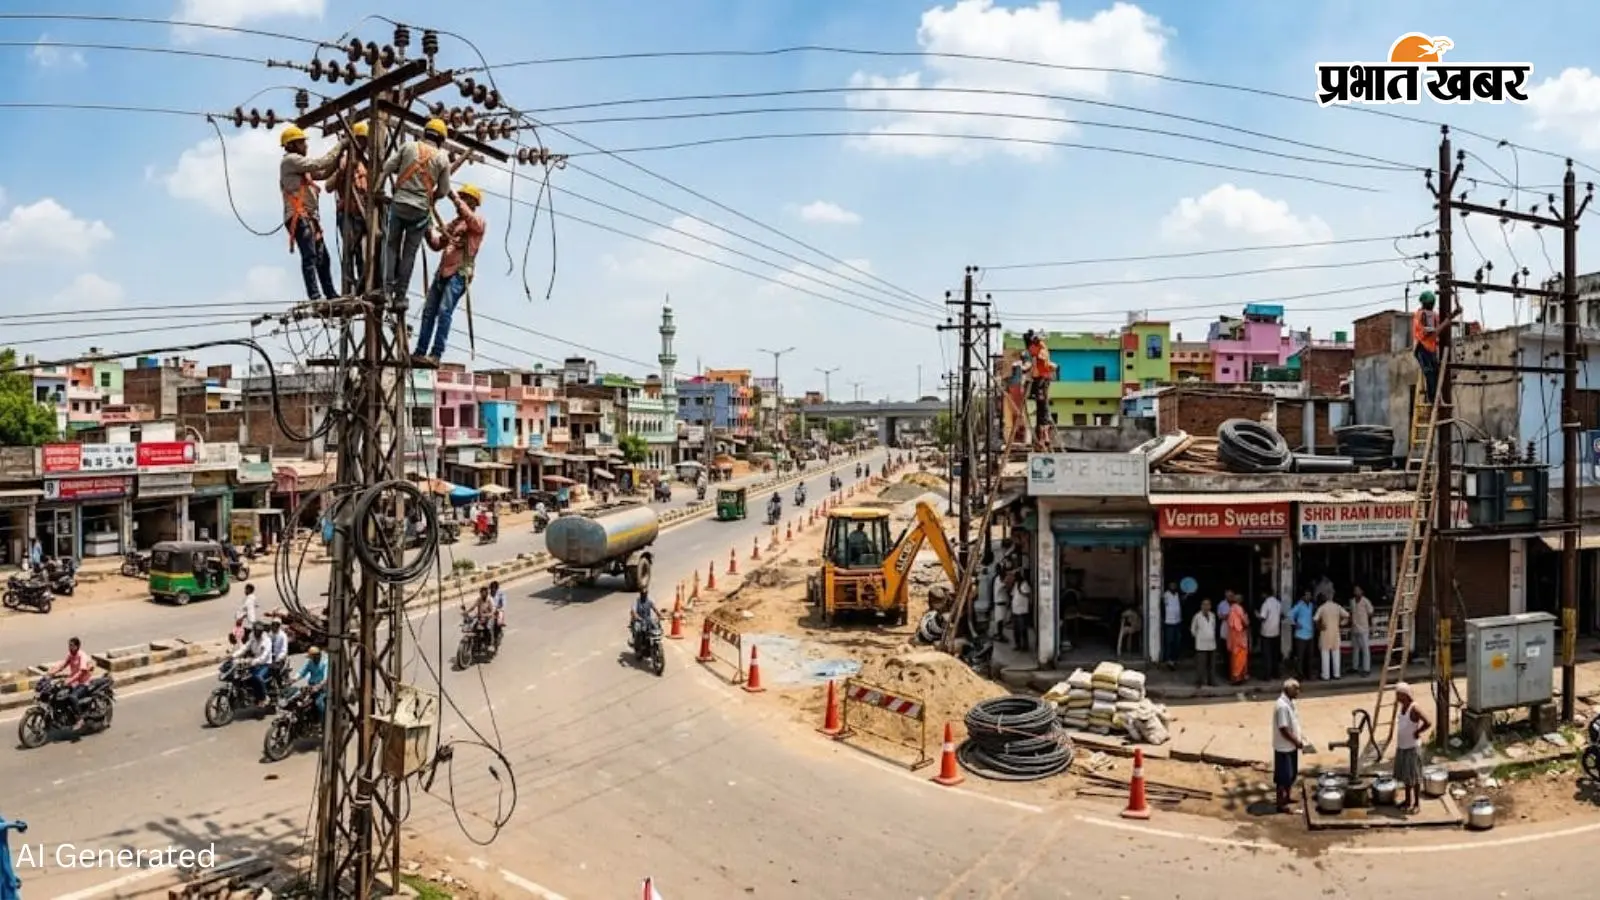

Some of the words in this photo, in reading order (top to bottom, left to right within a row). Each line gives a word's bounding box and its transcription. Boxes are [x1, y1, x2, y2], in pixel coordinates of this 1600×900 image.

[1164, 508, 1219, 527] Verma
[1224, 508, 1285, 526] Sweets
[1304, 507, 1336, 521] SHRI
[1340, 506, 1369, 520] RAM
